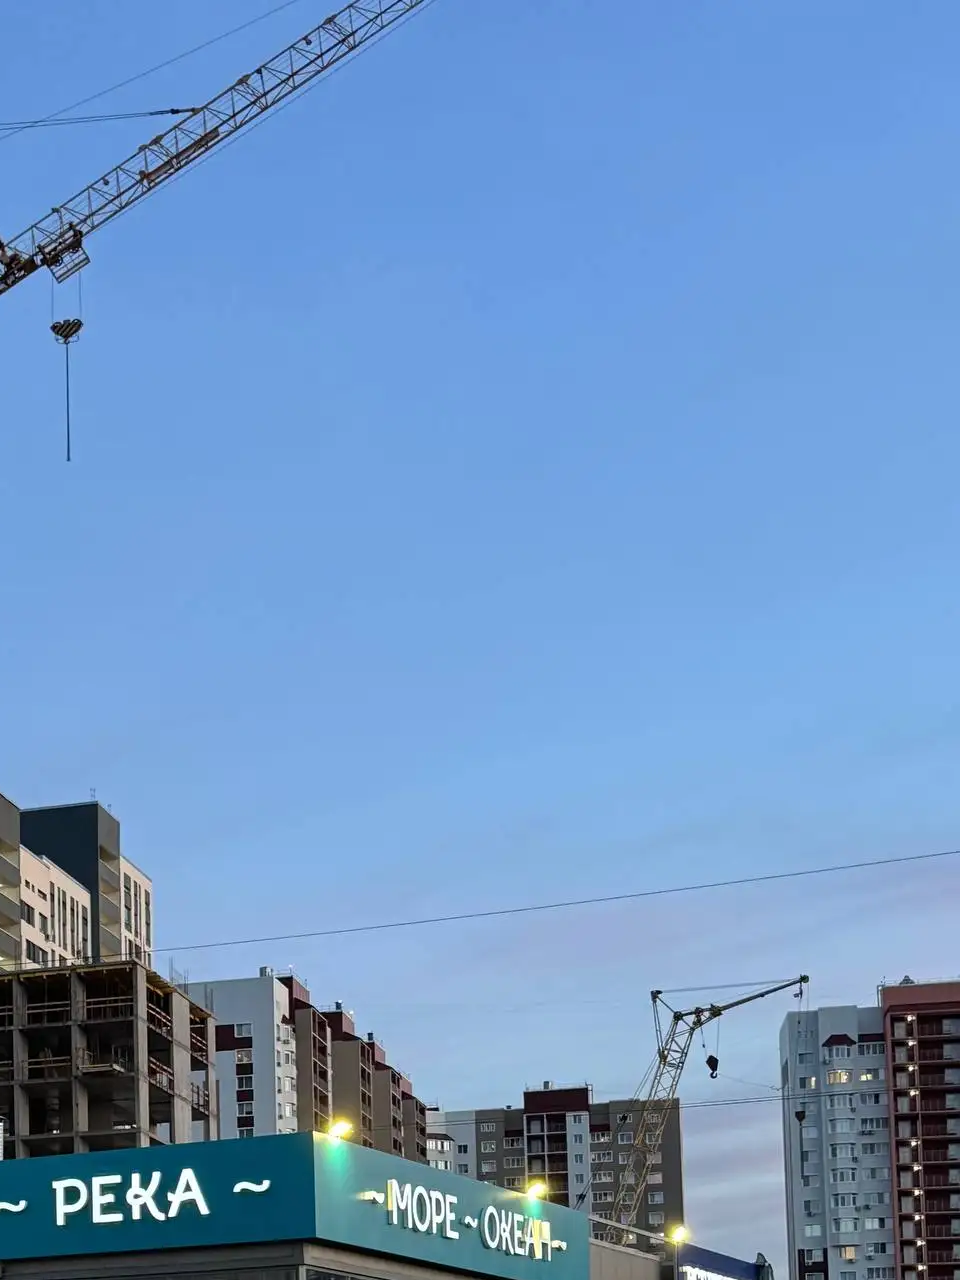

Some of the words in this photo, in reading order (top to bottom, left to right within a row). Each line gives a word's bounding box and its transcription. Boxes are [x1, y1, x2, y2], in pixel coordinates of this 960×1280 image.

[51, 1168, 211, 1226] РЕКА
[387, 1178, 460, 1240] МОРЕ
[481, 1205, 552, 1262] ОКЕАН
